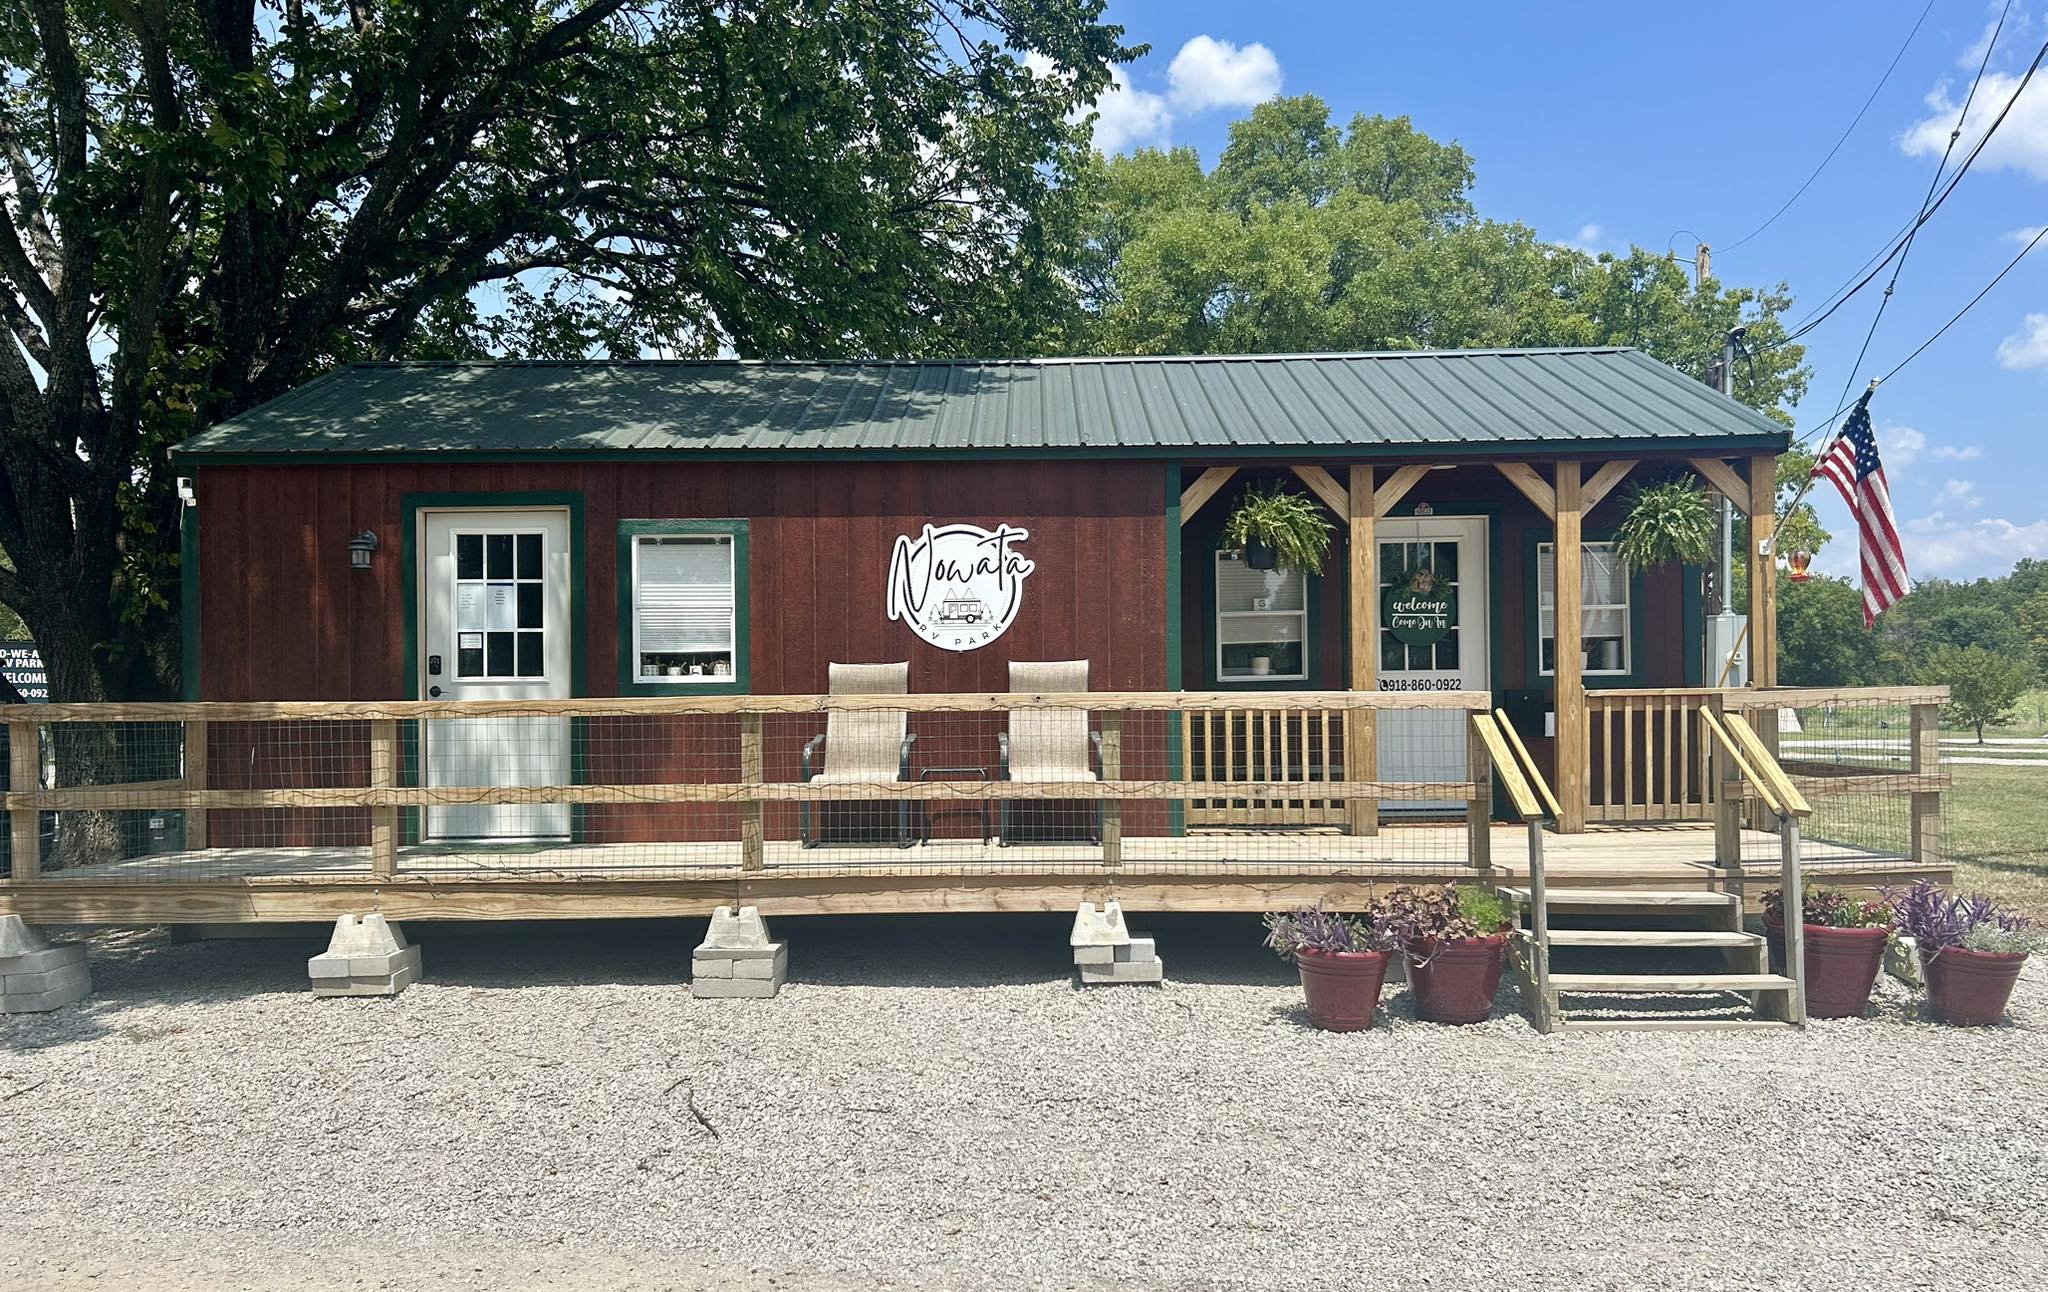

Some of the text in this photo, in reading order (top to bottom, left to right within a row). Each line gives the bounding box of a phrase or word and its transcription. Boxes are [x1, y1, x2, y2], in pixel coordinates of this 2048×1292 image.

[892, 528, 1031, 616] Nowata
[1392, 596, 1448, 613] welcome
[918, 623, 1002, 646] RV PARK
[2, 658, 14, 668] V
[2, 672, 48, 684] ELCOME
[1389, 679, 1461, 691] 918-860-0922
